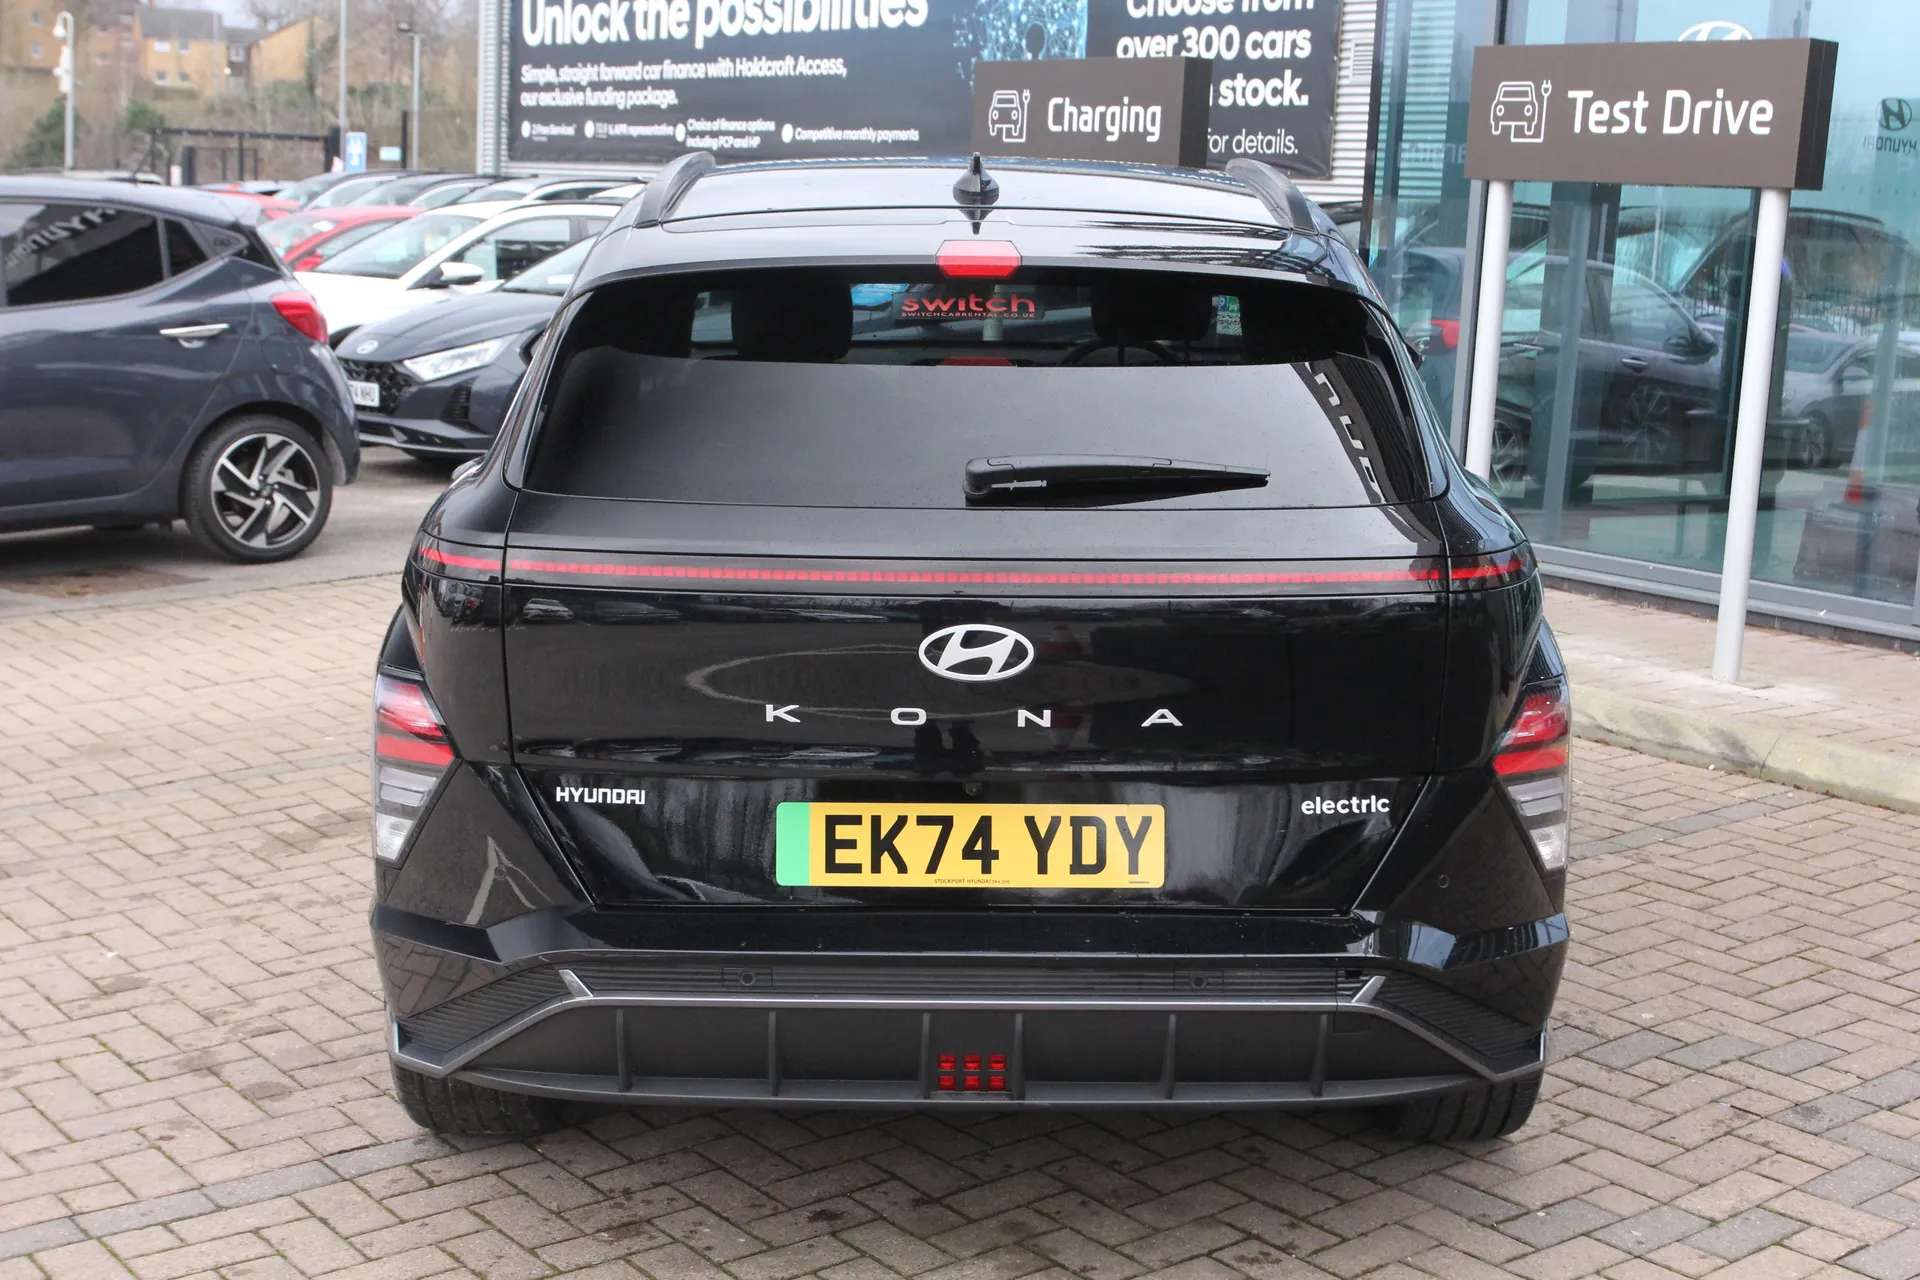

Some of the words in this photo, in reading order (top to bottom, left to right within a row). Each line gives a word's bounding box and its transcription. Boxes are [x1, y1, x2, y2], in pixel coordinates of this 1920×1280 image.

[522, 0, 631, 47] Unlock
[632, 0, 691, 40] the
[694, 0, 929, 49] possibilities
[1116, 34, 1179, 59] over
[1180, 25, 1241, 60] 300
[1245, 28, 1312, 60] cars
[643, 66, 661, 80] car
[662, 59, 706, 79] finance
[707, 57, 734, 78] with
[735, 55, 795, 77] Holdcroft
[795, 56, 847, 78] Access,
[520, 91, 538, 106] our
[538, 87, 585, 107] exclusive
[585, 86, 626, 109] funding
[1217, 69, 1309, 107] stock.
[1047, 96, 1162, 142] Charging
[1567, 90, 1649, 134] Test
[1662, 88, 1774, 135] Drive
[1232, 128, 1298, 154] details.
[901, 293, 1036, 313] switch
[765, 704, 1183, 728] KONA
[555, 786, 646, 805] HYUNDAI
[1300, 794, 1390, 815] electric
[824, 814, 1000, 875] EK74
[1023, 815, 1154, 876] YDY
